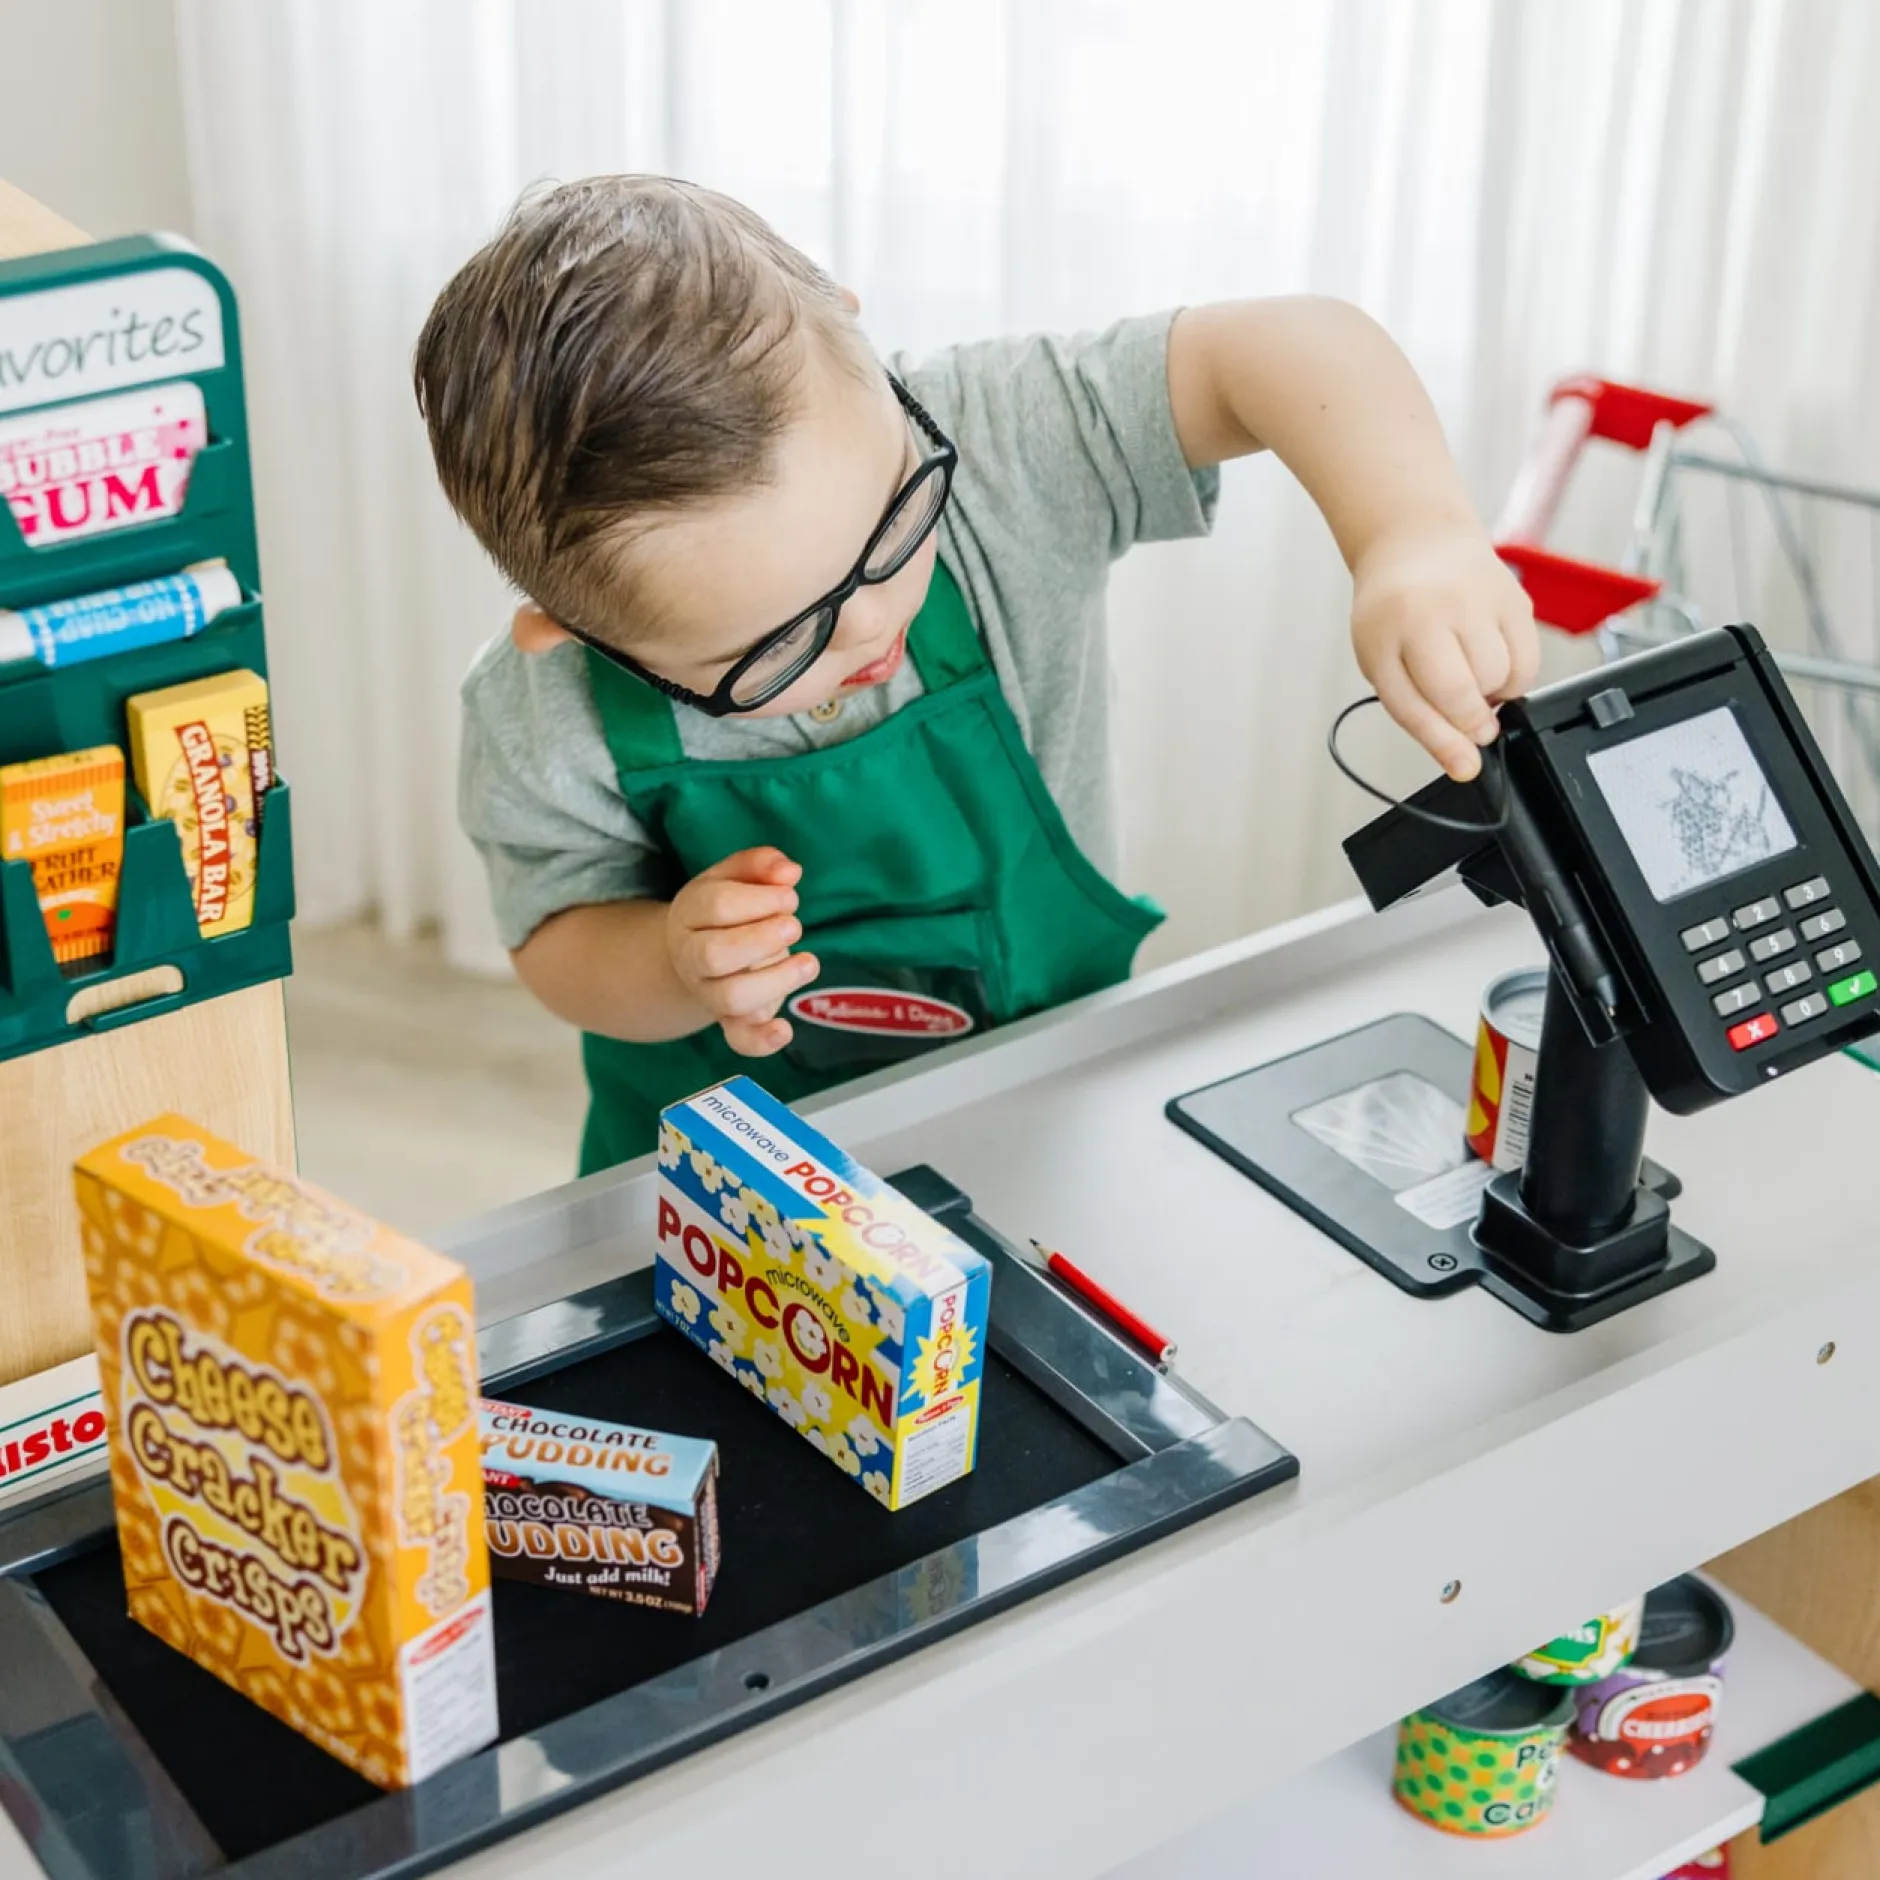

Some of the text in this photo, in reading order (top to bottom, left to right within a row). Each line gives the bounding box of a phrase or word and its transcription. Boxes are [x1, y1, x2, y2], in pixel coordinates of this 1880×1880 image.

[0, 308, 205, 387] vorites
[178, 724, 228, 925] GRANOLA BAR
[31, 846, 98, 873] RUIT
[1803, 885, 1814, 900] 3
[1753, 906, 1764, 920] 2
[1819, 917, 1830, 932] 6
[1701, 926, 1713, 941] 1
[1768, 937, 1779, 952] 5
[1717, 959, 1728, 974] 4
[1833, 948, 1844, 964] 9
[1783, 969, 1795, 985] 8
[1732, 991, 1743, 1006] 7
[1799, 1002, 1811, 1017] 0
[702, 1093, 944, 1280] microwave POPCORN
[657, 1195, 892, 1429] POPCORN
[765, 1266, 851, 1343] microwave
[933, 1294, 956, 1397] POPCORN
[128, 1311, 330, 1472] Cheese
[491, 1415, 661, 1450] CHOCOLATE
[479, 1433, 673, 1477] PUDDING
[129, 1402, 361, 1593] Cracker
[486, 1519, 684, 1569] UDDING
[168, 1516, 334, 1660] Crisps
[544, 1566, 671, 1587] Just add milk!
